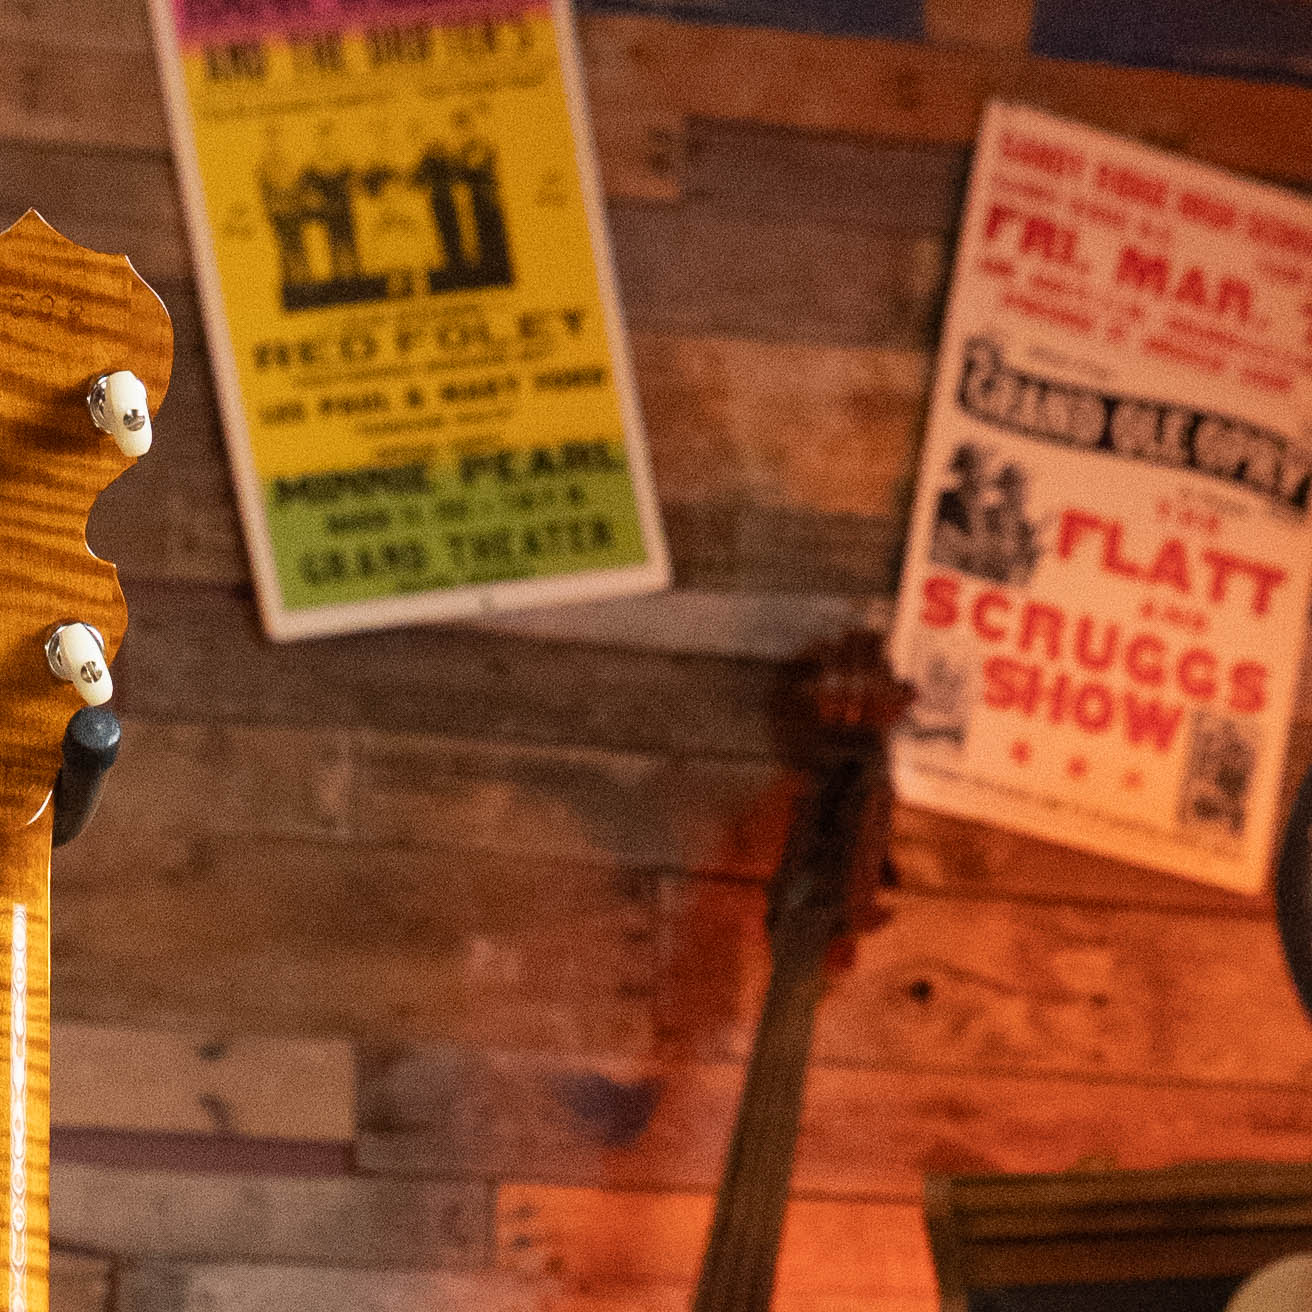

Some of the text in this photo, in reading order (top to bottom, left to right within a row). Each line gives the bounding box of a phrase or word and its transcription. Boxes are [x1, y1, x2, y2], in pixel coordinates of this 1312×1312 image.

[1053, 510, 1289, 616] FLATT
[921, 575, 1273, 714] SCRUGGS
[983, 656, 1185, 752] SHOW
